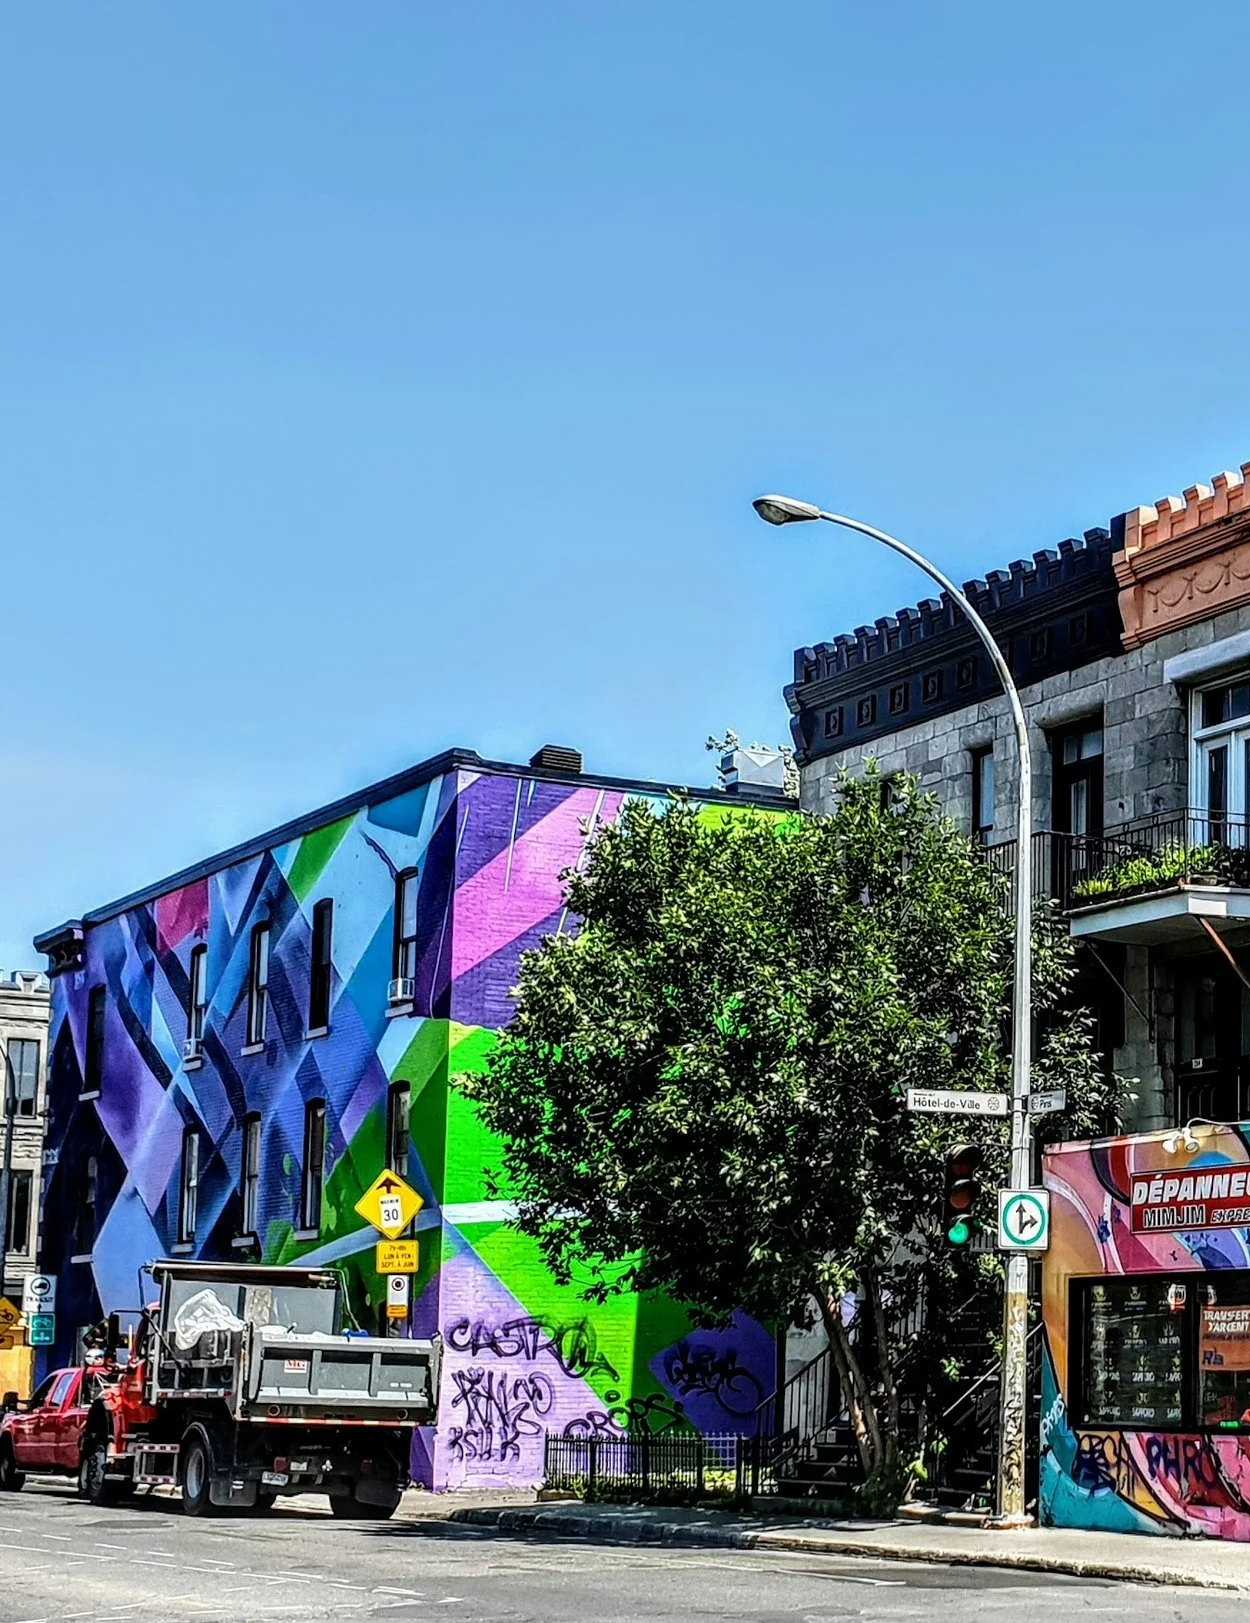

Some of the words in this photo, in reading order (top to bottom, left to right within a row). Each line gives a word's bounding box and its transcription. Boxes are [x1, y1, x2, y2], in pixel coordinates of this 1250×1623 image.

[913, 1097, 981, 1110] Hôtel-de-Ville
[383, 1209, 399, 1222] 30
[1143, 1204, 1206, 1228] MIMJIM
